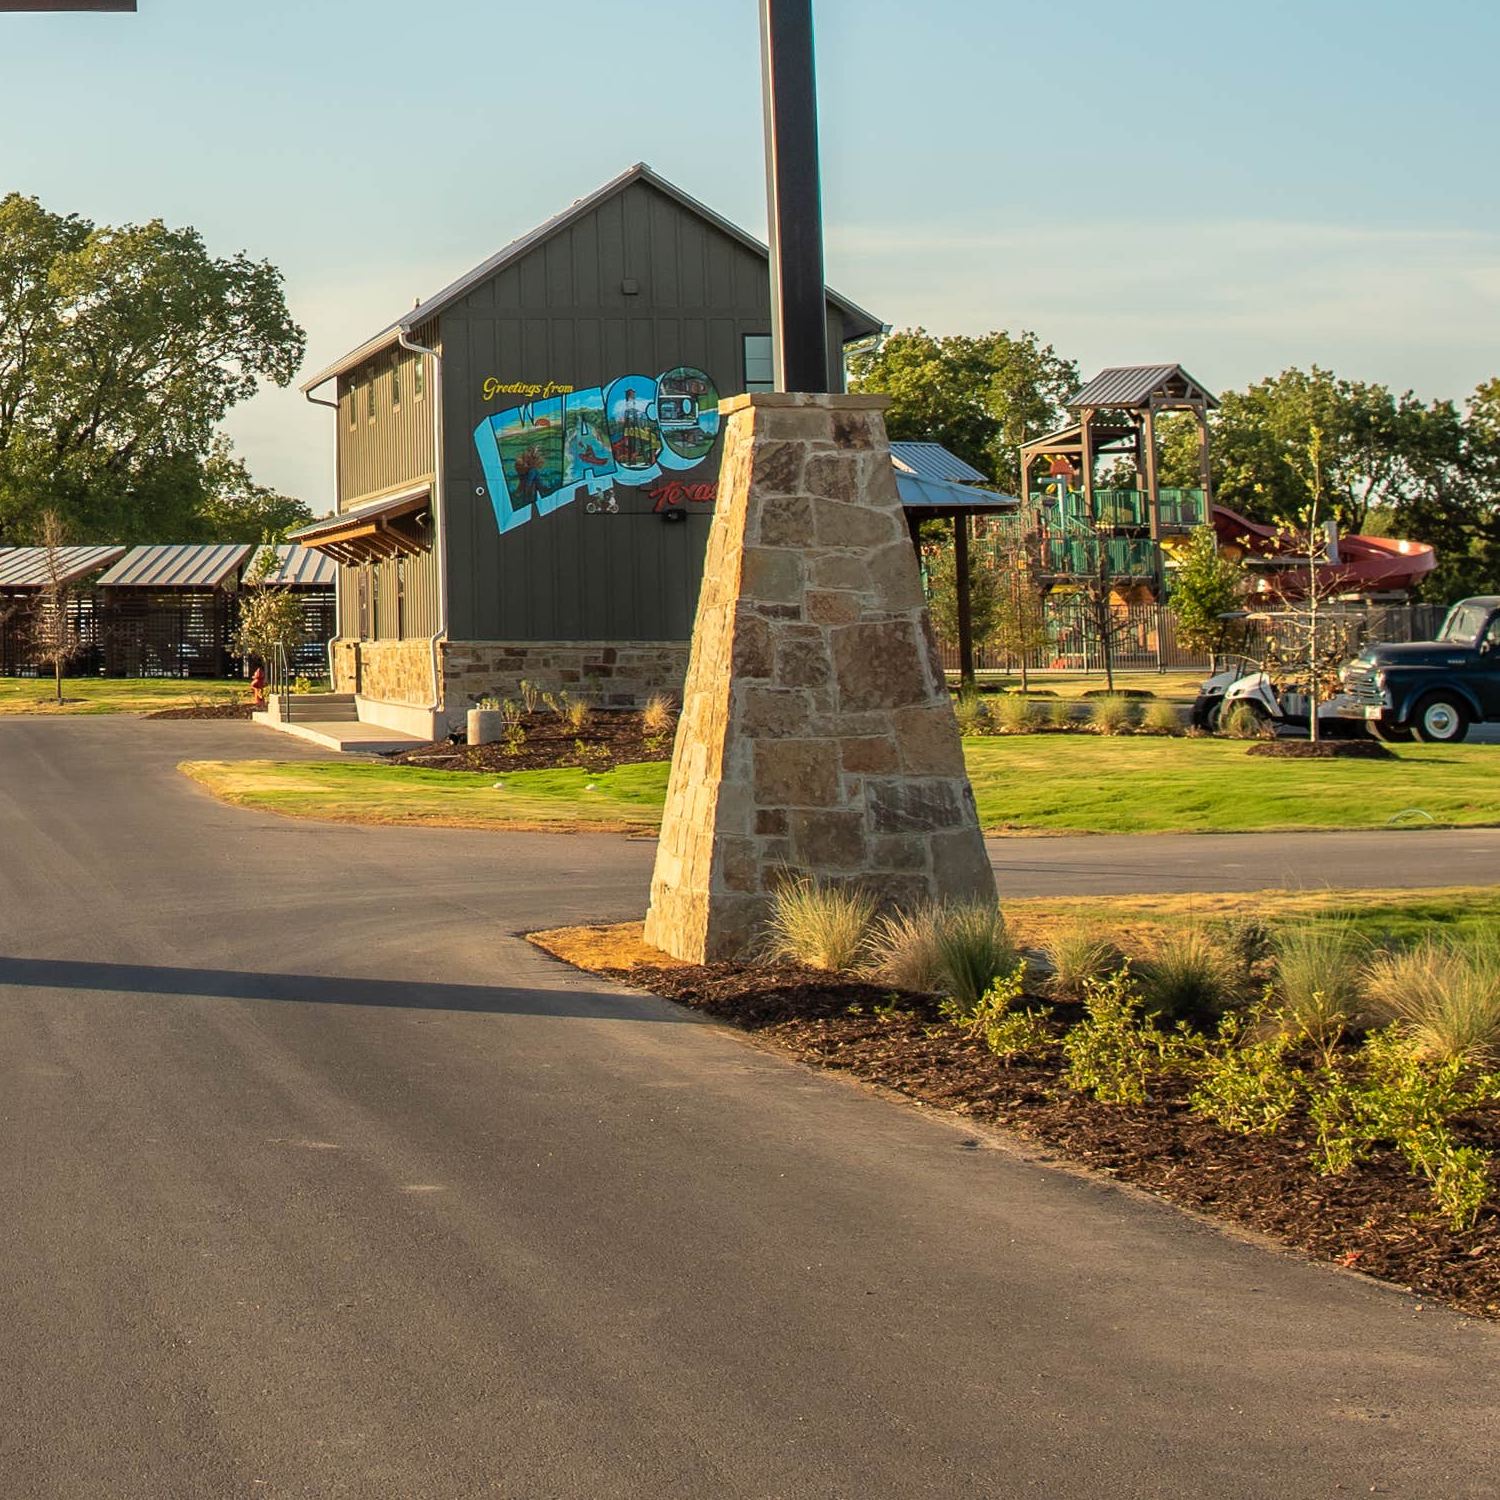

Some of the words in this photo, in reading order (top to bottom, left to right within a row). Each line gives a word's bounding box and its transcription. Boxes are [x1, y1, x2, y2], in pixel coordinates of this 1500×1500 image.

[483, 377, 542, 401] Greetings
[542, 381, 573, 399] from
[475, 366, 720, 533] WACO
